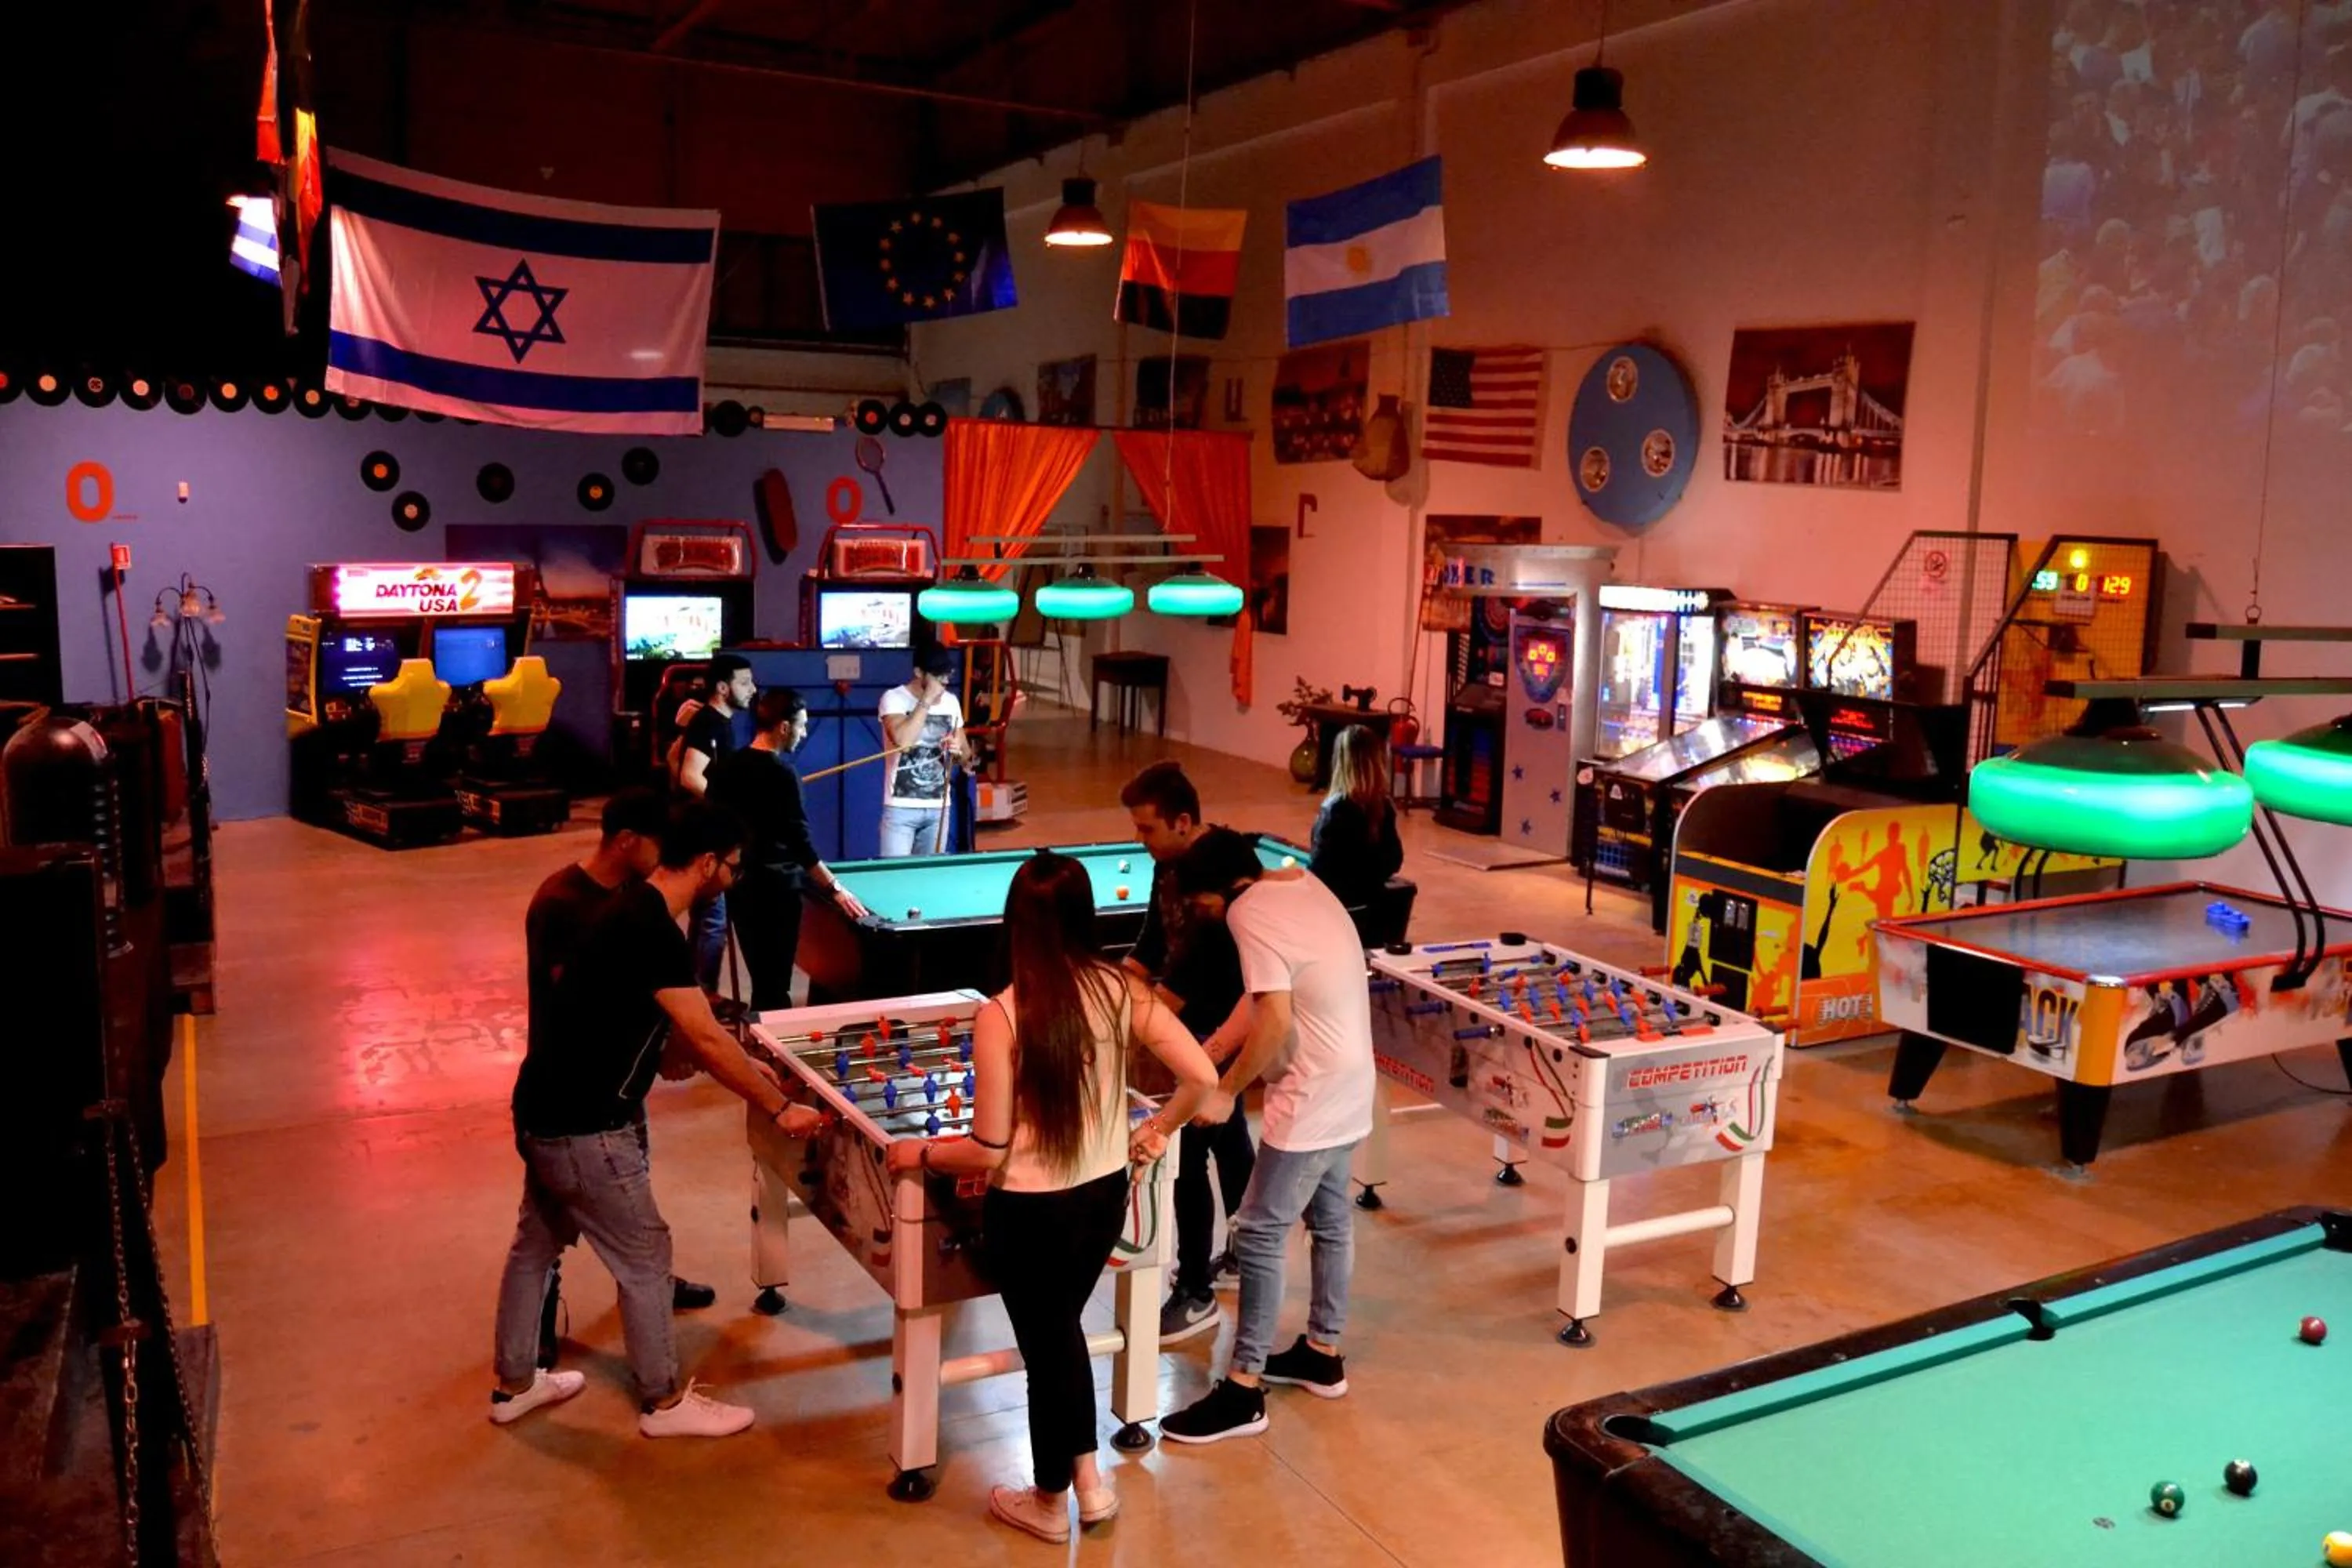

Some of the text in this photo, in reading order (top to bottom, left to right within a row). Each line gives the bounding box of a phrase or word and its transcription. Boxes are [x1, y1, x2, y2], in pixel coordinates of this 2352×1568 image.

[376, 583, 458, 599] DAYTONA
[459, 568, 483, 612] 2
[2075, 573, 2089, 592] 0
[2103, 576, 2132, 594] 129
[419, 599, 458, 612] USA
[1820, 996, 1862, 1020] HOT
[1628, 1054, 1748, 1090] COMPETITION
